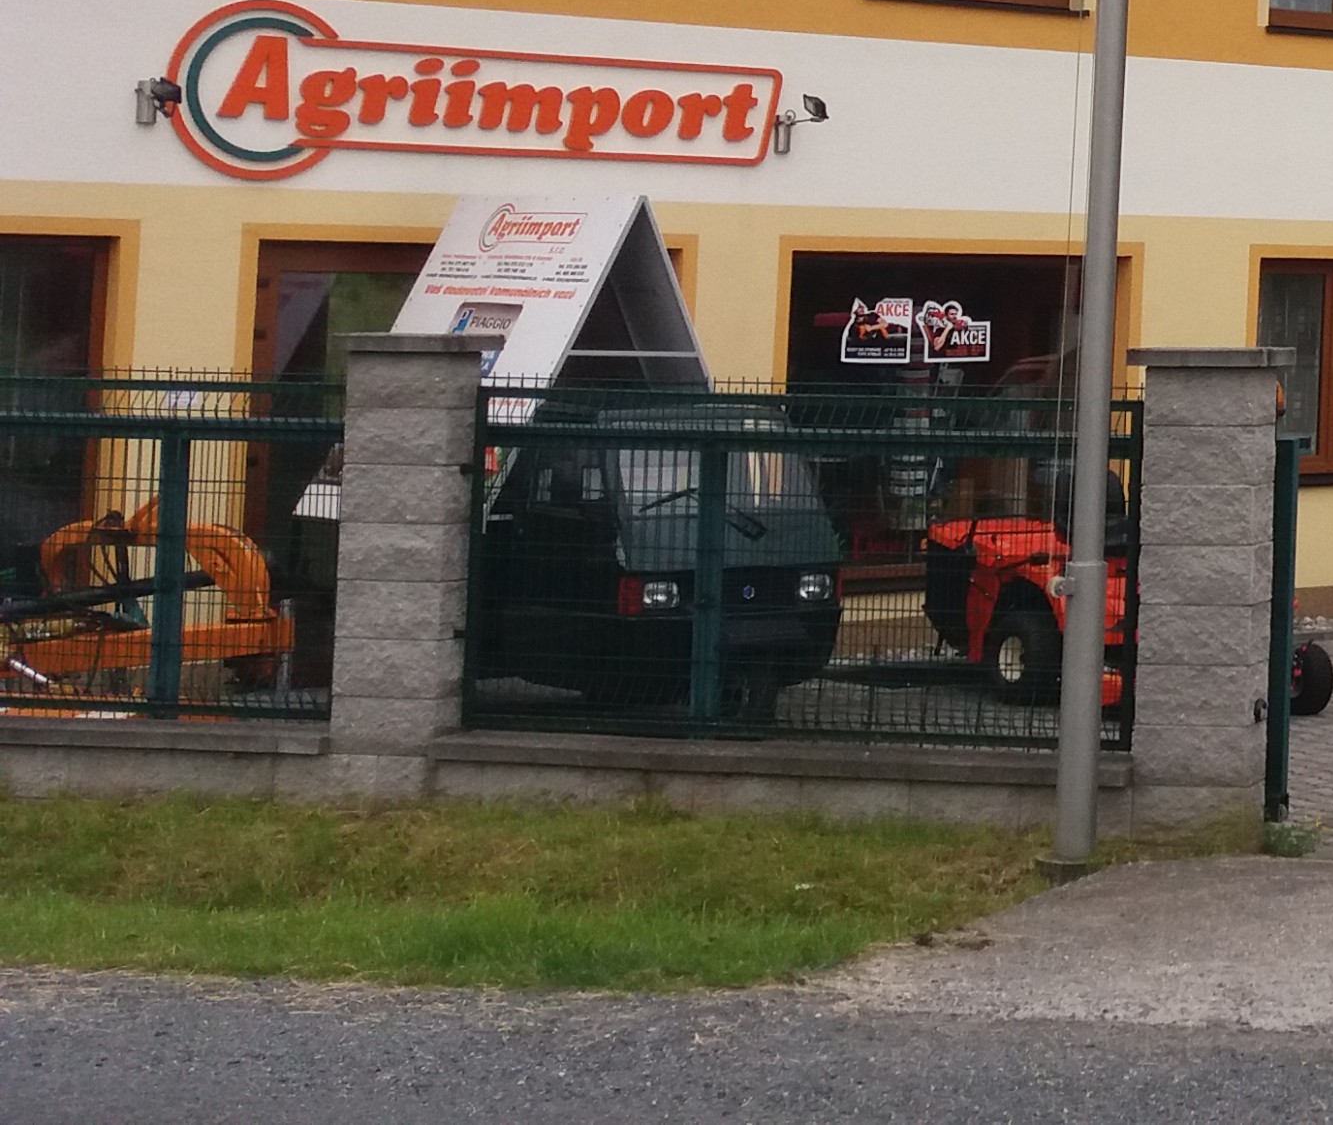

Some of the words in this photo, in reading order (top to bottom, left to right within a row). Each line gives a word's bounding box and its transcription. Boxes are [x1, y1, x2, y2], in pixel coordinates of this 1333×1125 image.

[217, 35, 759, 151] Agriimport
[488, 212, 581, 241] Agriimport
[876, 303, 910, 317] AKCE
[470, 316, 512, 330] PIAGGIO
[950, 330, 986, 346] AKCE
